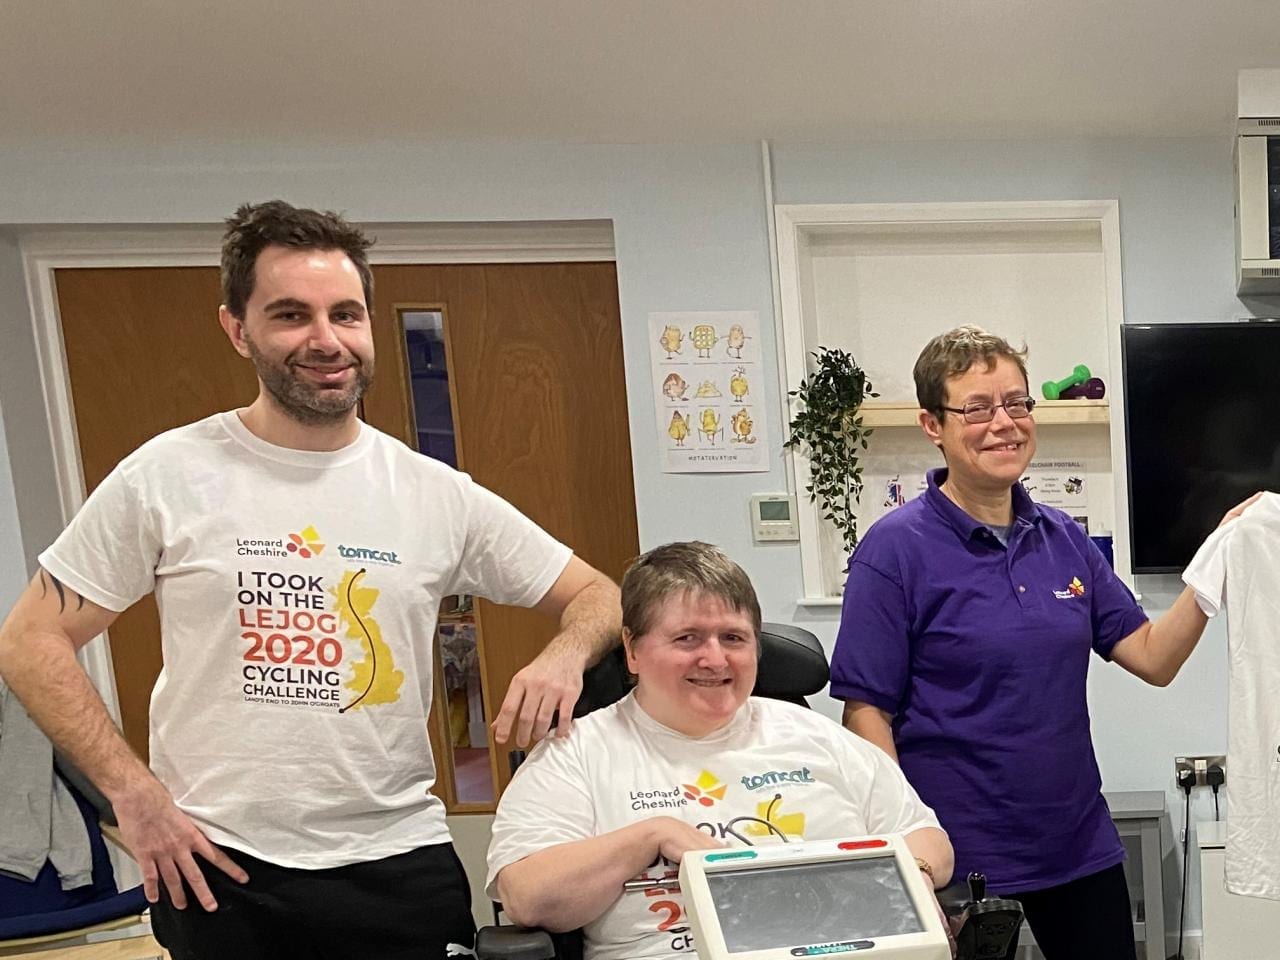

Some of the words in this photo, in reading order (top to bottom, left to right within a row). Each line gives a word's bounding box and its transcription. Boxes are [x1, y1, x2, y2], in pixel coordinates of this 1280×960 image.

[236, 538, 283, 548] Leonard
[237, 547, 288, 558] Cheshire
[337, 544, 402, 564] tomcat
[237, 571, 242, 588] I
[252, 571, 324, 592] TOOK
[237, 590, 272, 606] ON
[279, 592, 324, 610] THE
[239, 608, 336, 634] LEJOG
[240, 631, 343, 668] 2020
[243, 665, 340, 686] CYCLING
[243, 683, 340, 701] CHALLENGE
[741, 767, 816, 790] tomcat
[630, 787, 681, 800] Leonard
[631, 797, 688, 811] Cheshire
